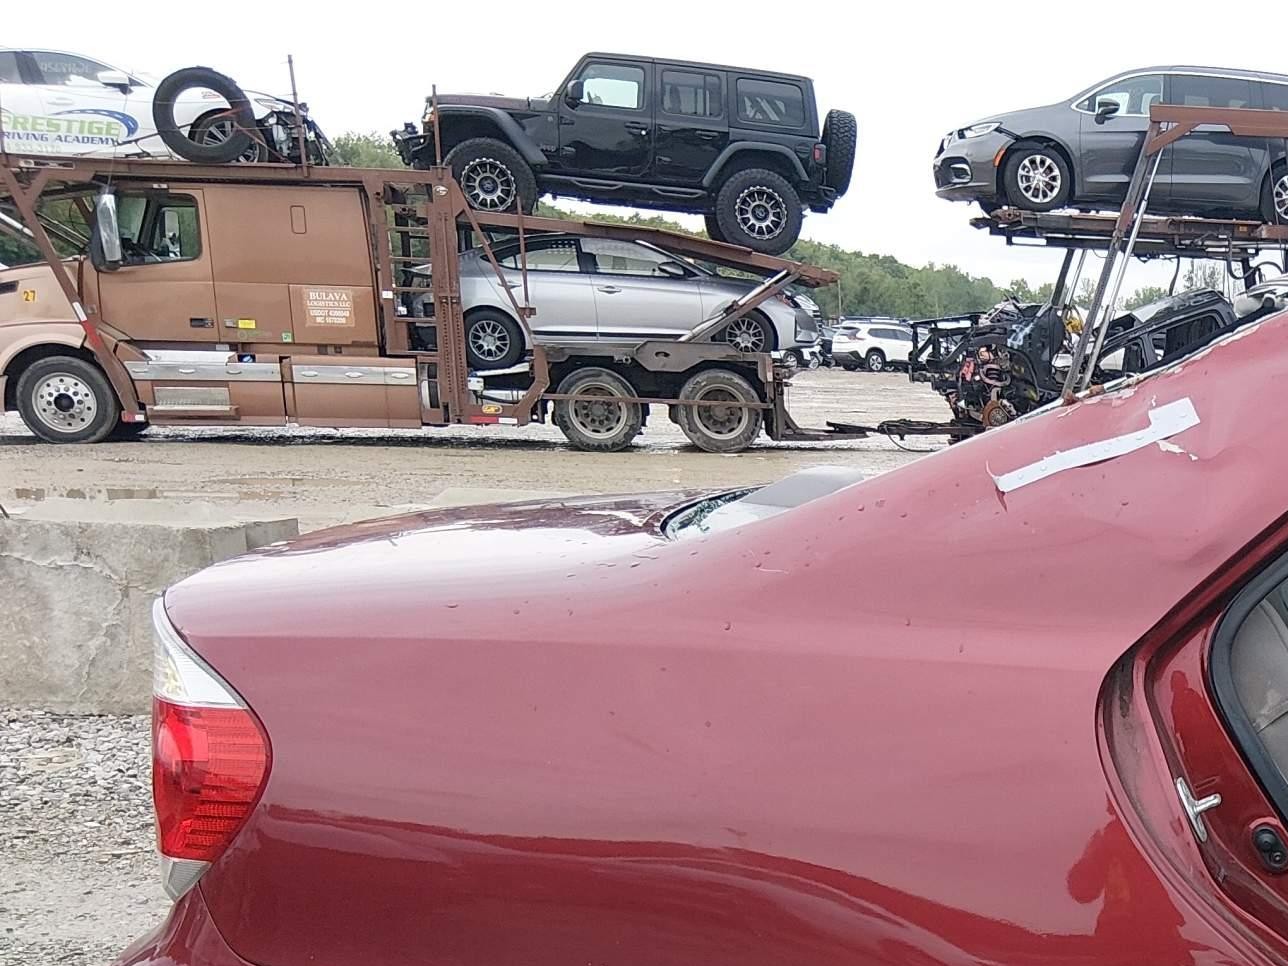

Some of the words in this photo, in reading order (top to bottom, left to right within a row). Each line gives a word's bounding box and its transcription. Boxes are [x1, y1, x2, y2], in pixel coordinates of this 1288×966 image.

[0, 114, 121, 136] PRESTIGE
[56, 134, 117, 146] ACADEMY
[23, 290, 36, 301] 27
